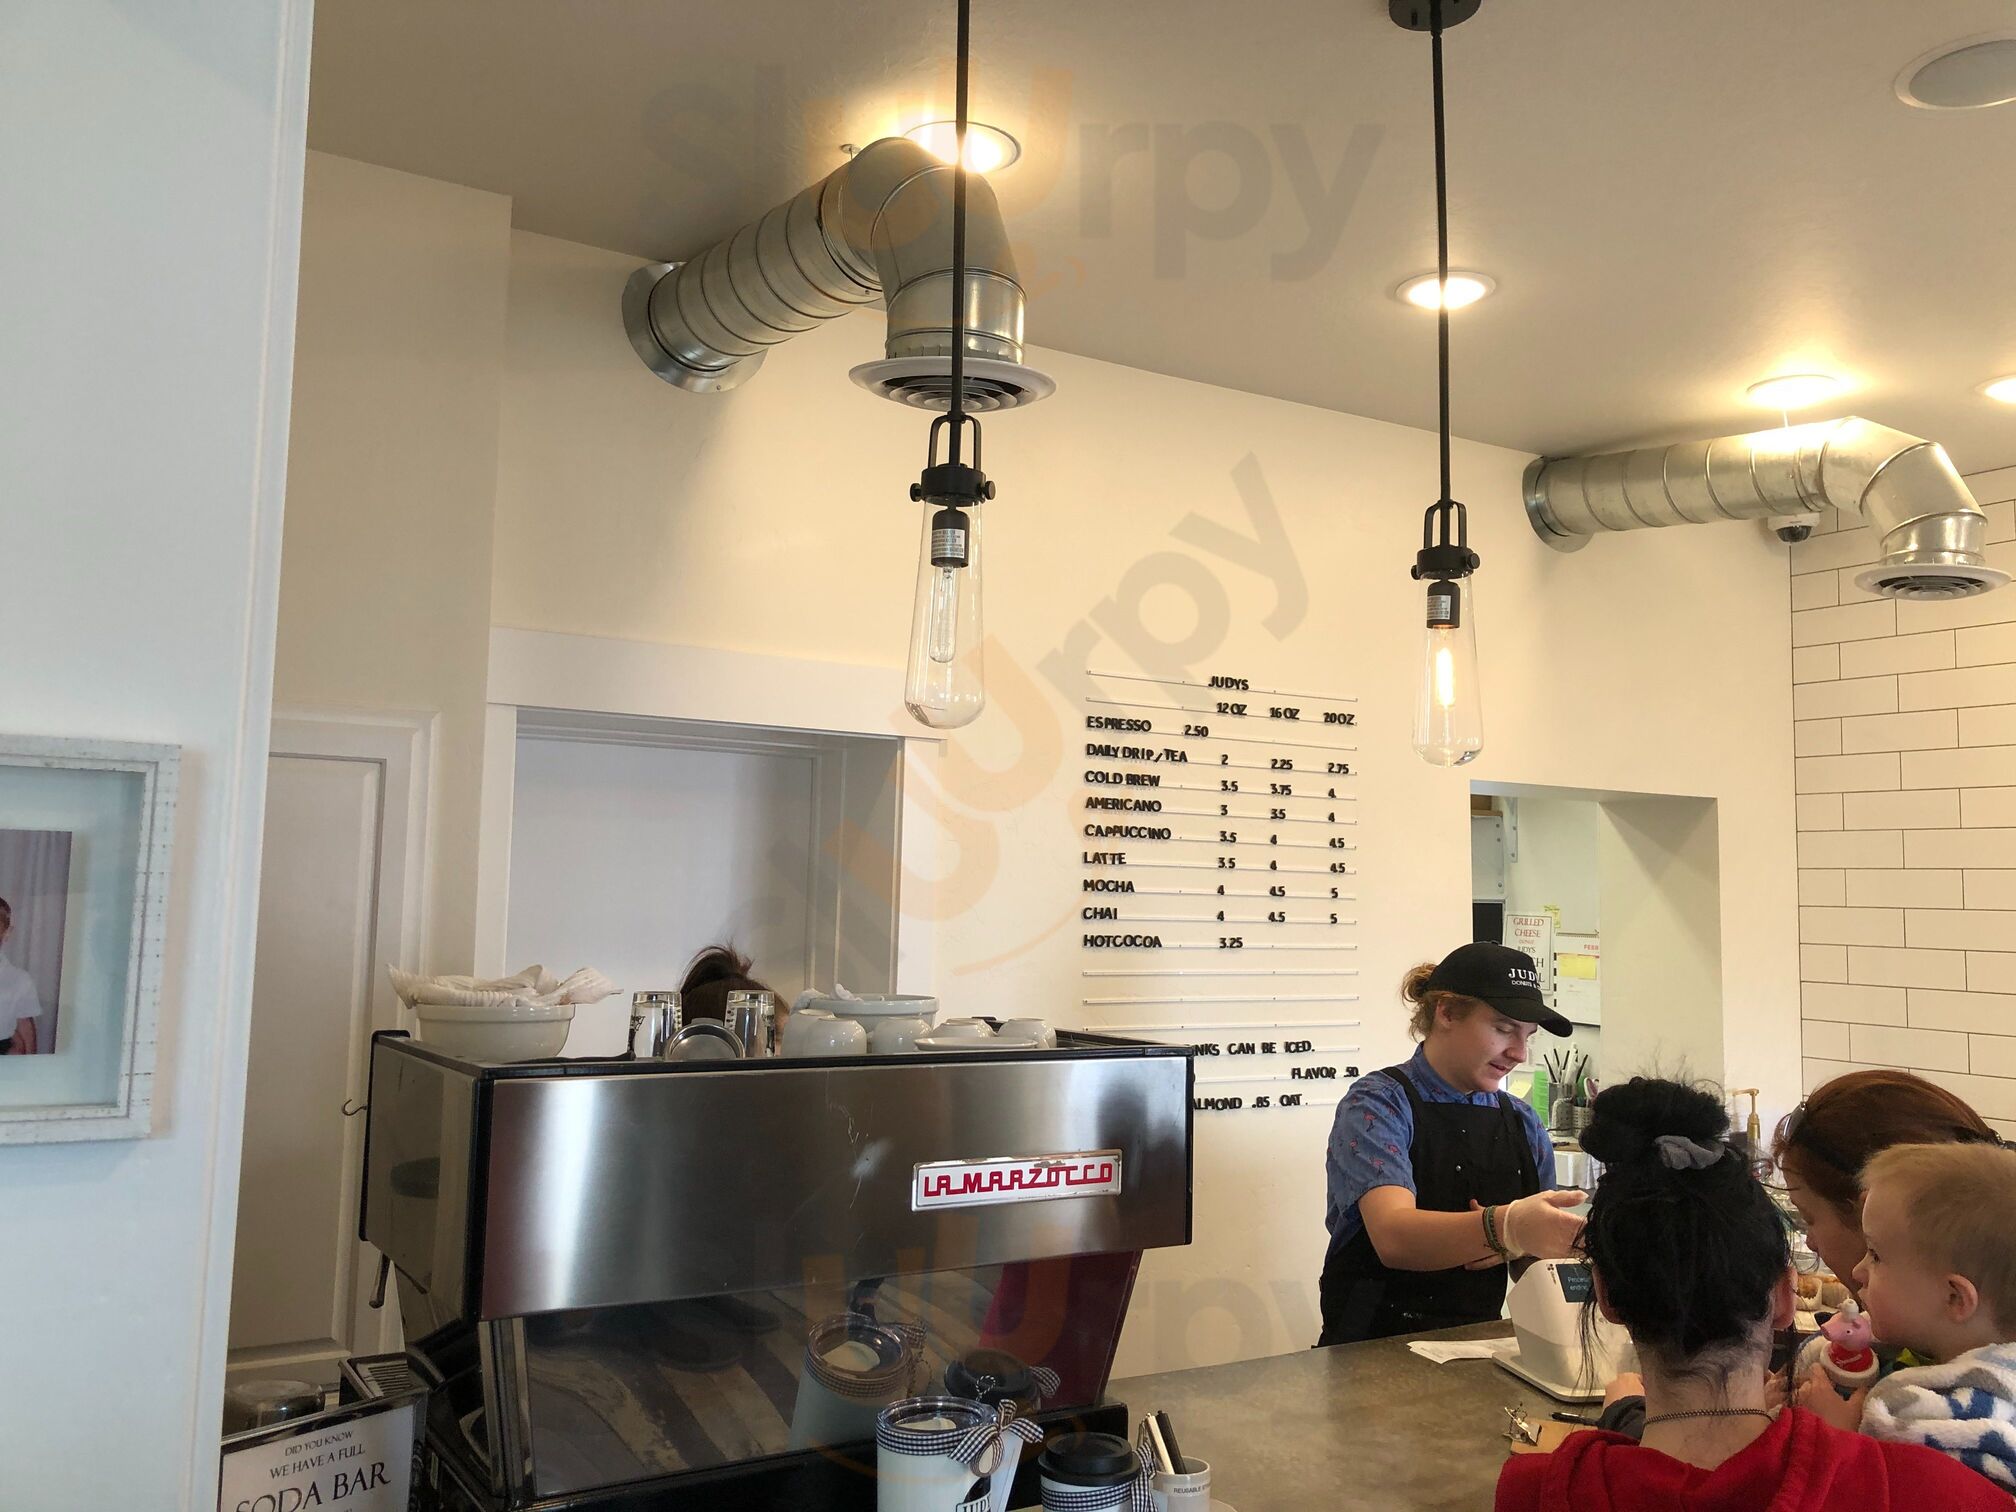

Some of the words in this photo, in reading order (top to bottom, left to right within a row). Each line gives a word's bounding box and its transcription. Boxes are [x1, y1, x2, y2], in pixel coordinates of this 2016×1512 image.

[1208, 676, 1249, 690] JUDYS
[1217, 702, 1229, 714] 12
[1230, 703, 1248, 716] OZ
[1269, 707, 1282, 718] 16
[1283, 708, 1300, 720] OZ
[1086, 715, 1152, 732] ESPRESSO
[1184, 725, 1209, 737] 2.50
[1086, 743, 1119, 758] DAILY
[1220, 754, 1229, 765] 2
[1271, 758, 1293, 770] 2.25
[1327, 762, 1350, 774] 2.75
[1084, 770, 1123, 785] COLD
[1125, 773, 1160, 787] BREW
[1220, 780, 1239, 792] 3.5
[1270, 783, 1292, 796] 3.75
[1085, 796, 1162, 812] AMERICANO
[1220, 804, 1228, 816] 3
[1327, 812, 1335, 822] 4
[1084, 824, 1171, 840] CAPPUCCINO
[1219, 830, 1237, 843] 3.5
[1270, 834, 1278, 845] 4
[1083, 851, 1127, 865] LATTE
[1217, 857, 1236, 869] 3.5
[1269, 860, 1277, 870] 4
[1083, 879, 1135, 893] MOCHA
[1217, 885, 1225, 895] 4
[1269, 886, 1286, 897] 4.5
[1331, 887, 1338, 898] 5
[1082, 906, 1118, 920] CHAI
[1217, 911, 1225, 921] 4
[1268, 911, 1286, 923] 4.5
[1330, 913, 1338, 924] 5
[1219, 937, 1244, 949] 3.25
[1227, 1042, 1256, 1055] CAN
[1261, 1041, 1276, 1054] BE
[1284, 1040, 1315, 1053] ICED.
[1291, 1066, 1336, 1079] FLAVOR
[285, 1445, 302, 1456] DID
[304, 1438, 323, 1451] YOU
[324, 1431, 353, 1444] KNOW
[270, 1463, 289, 1479] WE
[292, 1454, 325, 1474] HAVE
[327, 1452, 335, 1464] A
[338, 1443, 366, 1460] FULL
[332, 1461, 391, 1500] BAR
